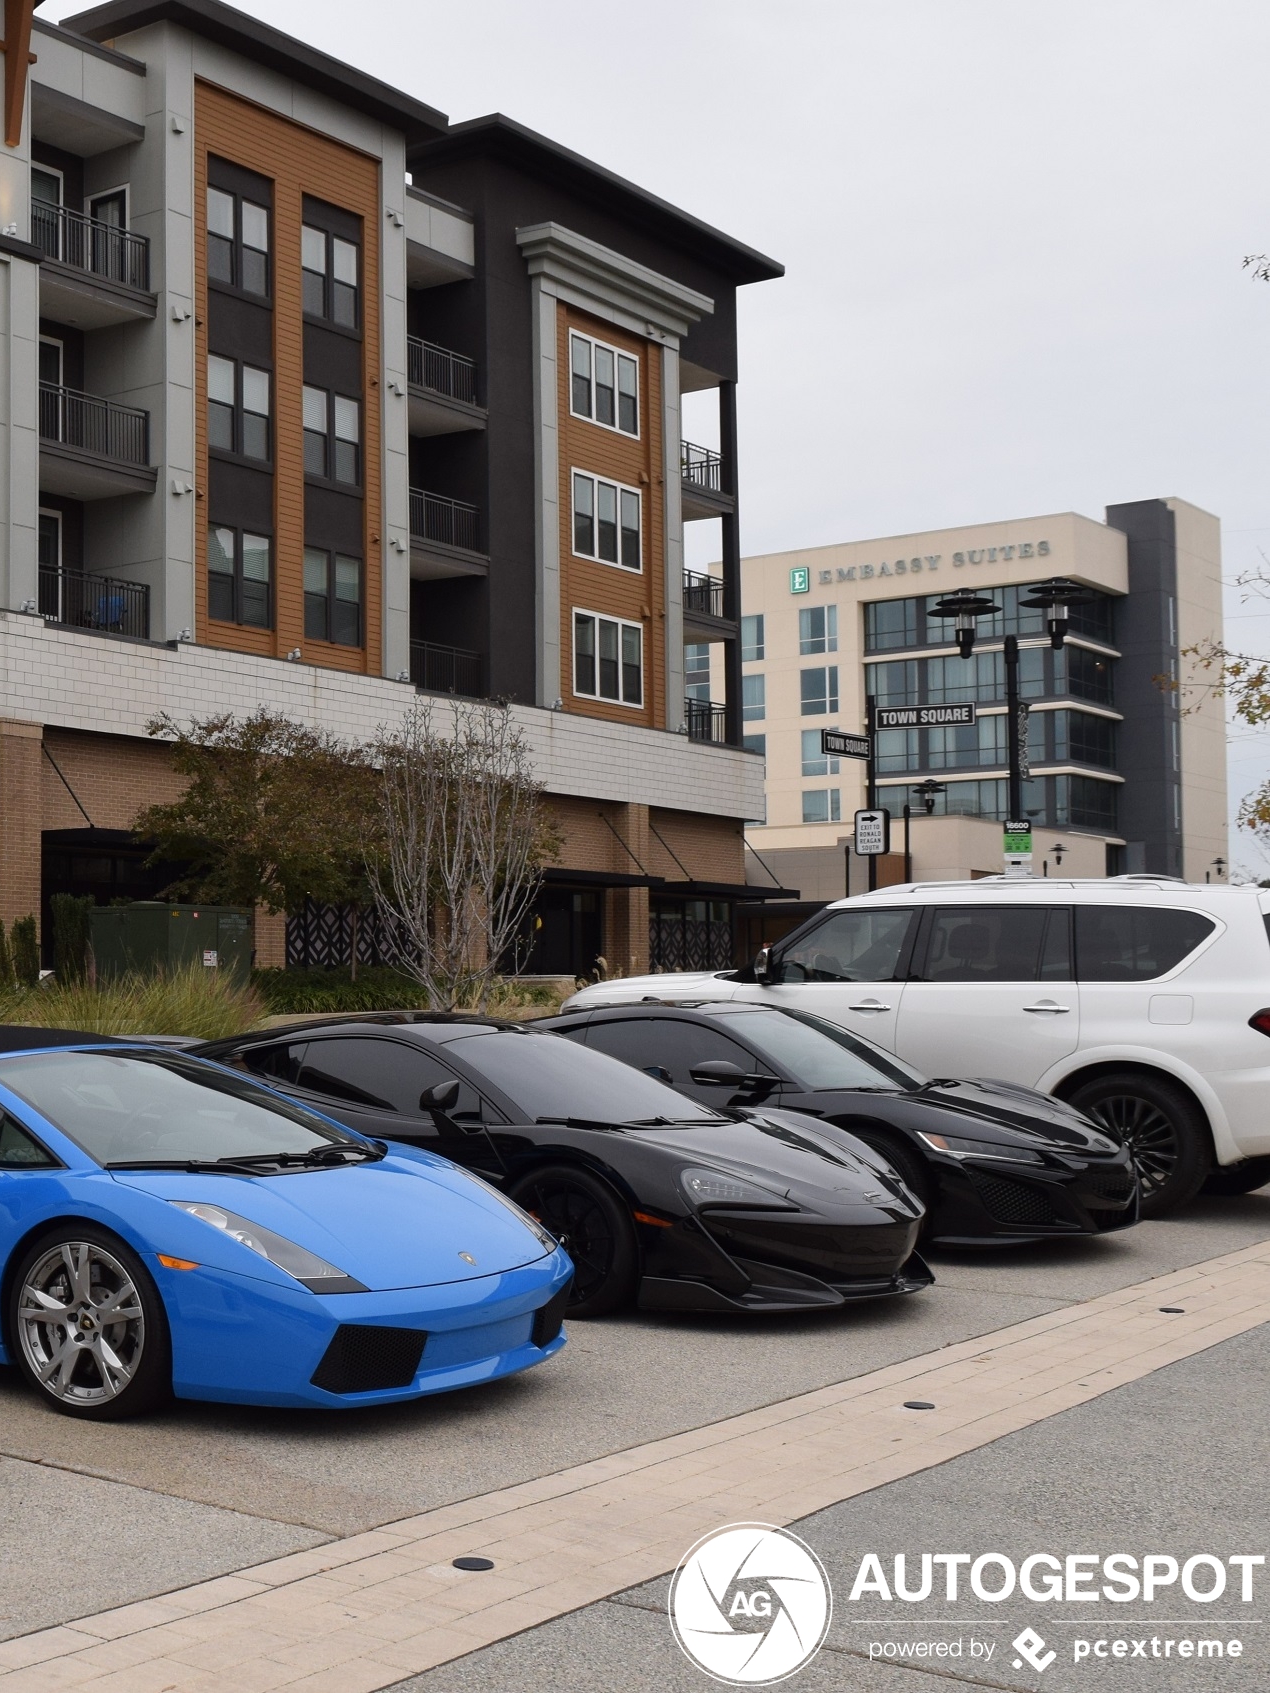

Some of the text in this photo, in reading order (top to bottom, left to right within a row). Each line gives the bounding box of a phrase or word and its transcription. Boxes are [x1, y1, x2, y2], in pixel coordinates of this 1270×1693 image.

[819, 554, 941, 585] EMBASSY
[952, 540, 1051, 567] SUITES
[881, 707, 970, 725] TOWN SQUARE
[827, 736, 868, 754] TOWN SQUARE
